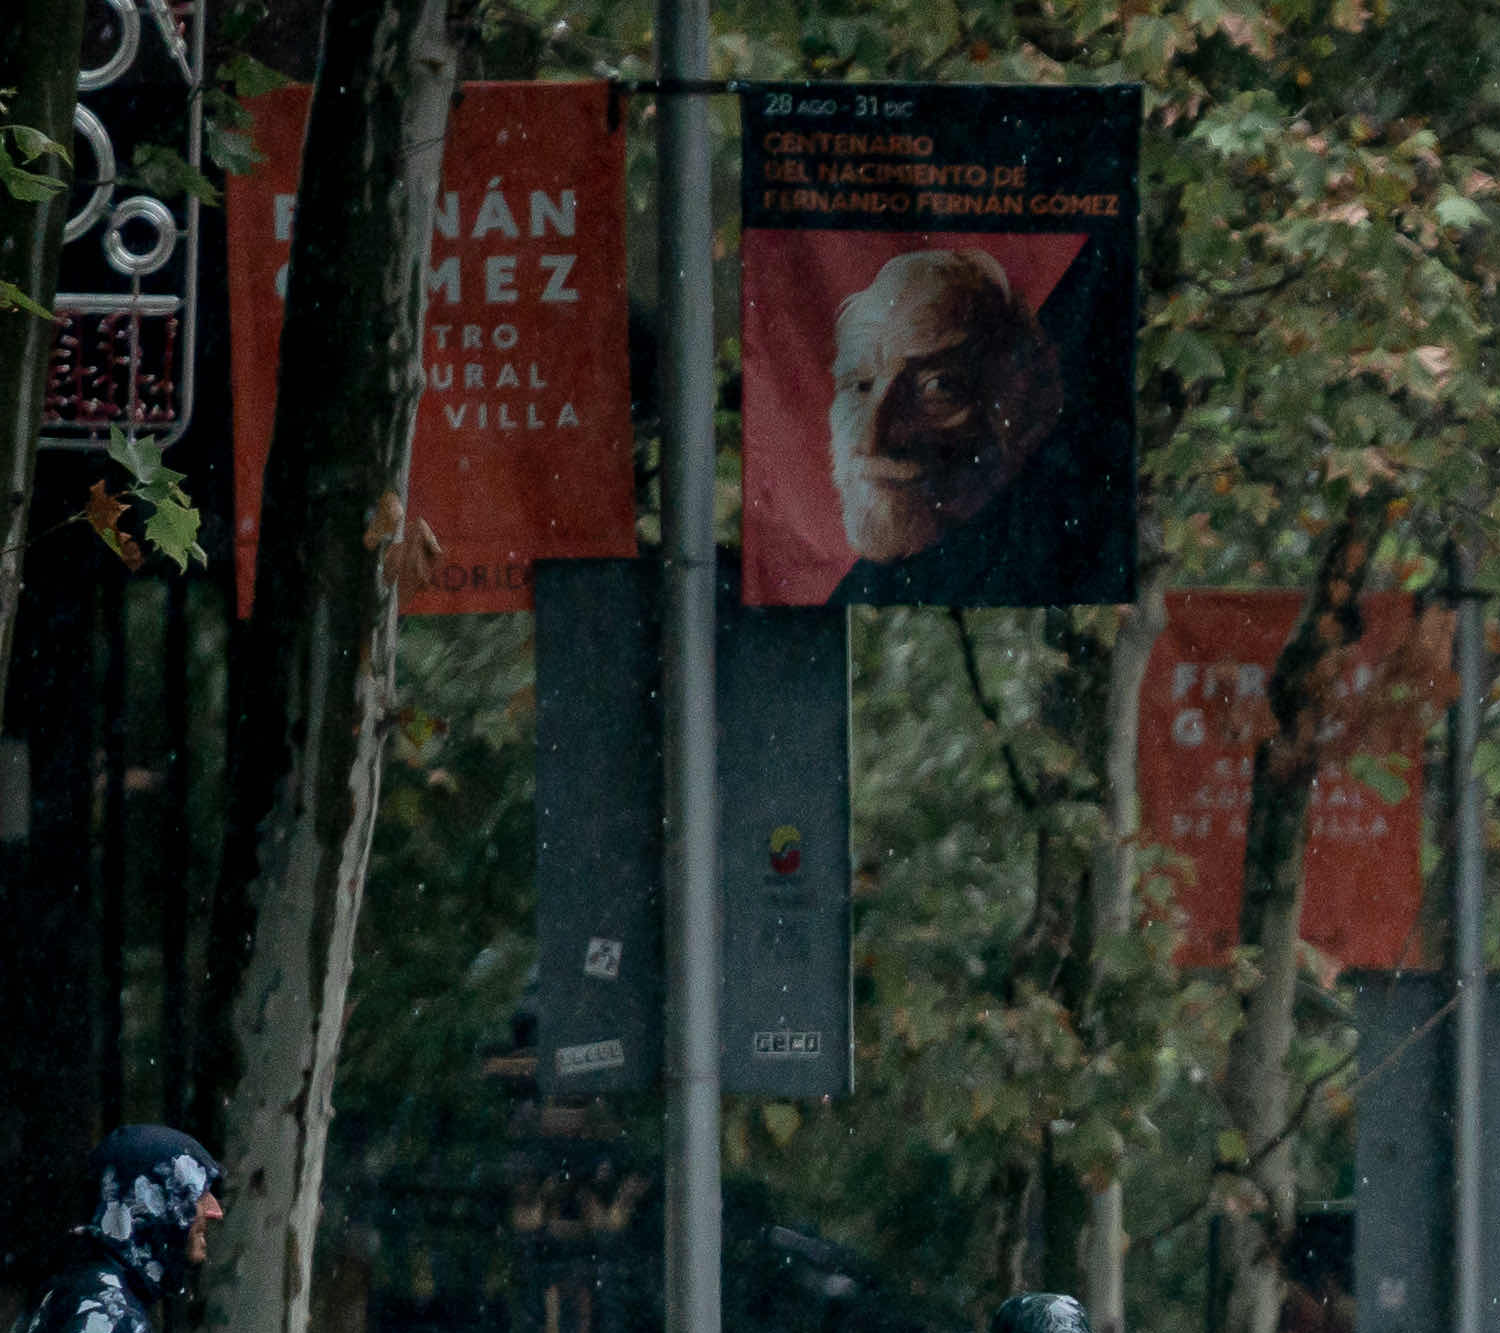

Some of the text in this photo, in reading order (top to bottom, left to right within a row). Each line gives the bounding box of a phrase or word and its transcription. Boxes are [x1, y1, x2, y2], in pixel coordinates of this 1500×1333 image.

[763, 131, 934, 157] CENTENARIO
[763, 160, 1027, 189] DEL NACIMIENTO DE
[763, 191, 911, 214] FERNANDO
[431, 323, 519, 351] TRO
[444, 402, 580, 429] VILLA
